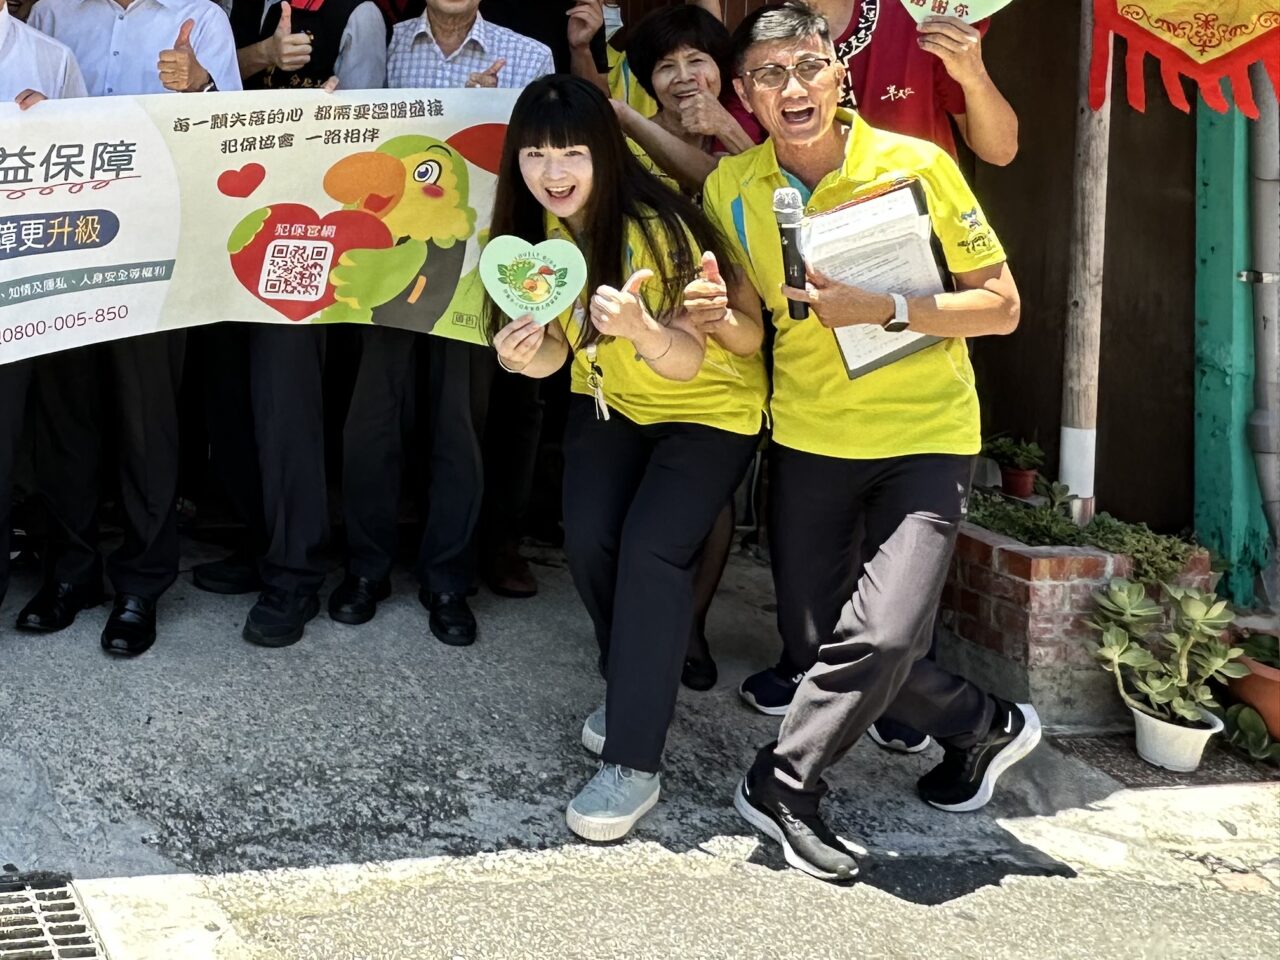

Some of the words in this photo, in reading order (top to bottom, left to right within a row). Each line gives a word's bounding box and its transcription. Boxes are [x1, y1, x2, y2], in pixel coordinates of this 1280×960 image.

[220, 132, 296, 155] 犯保協會
[304, 126, 381, 146] 一路相伴
[273, 222, 338, 239] 犯保官網
